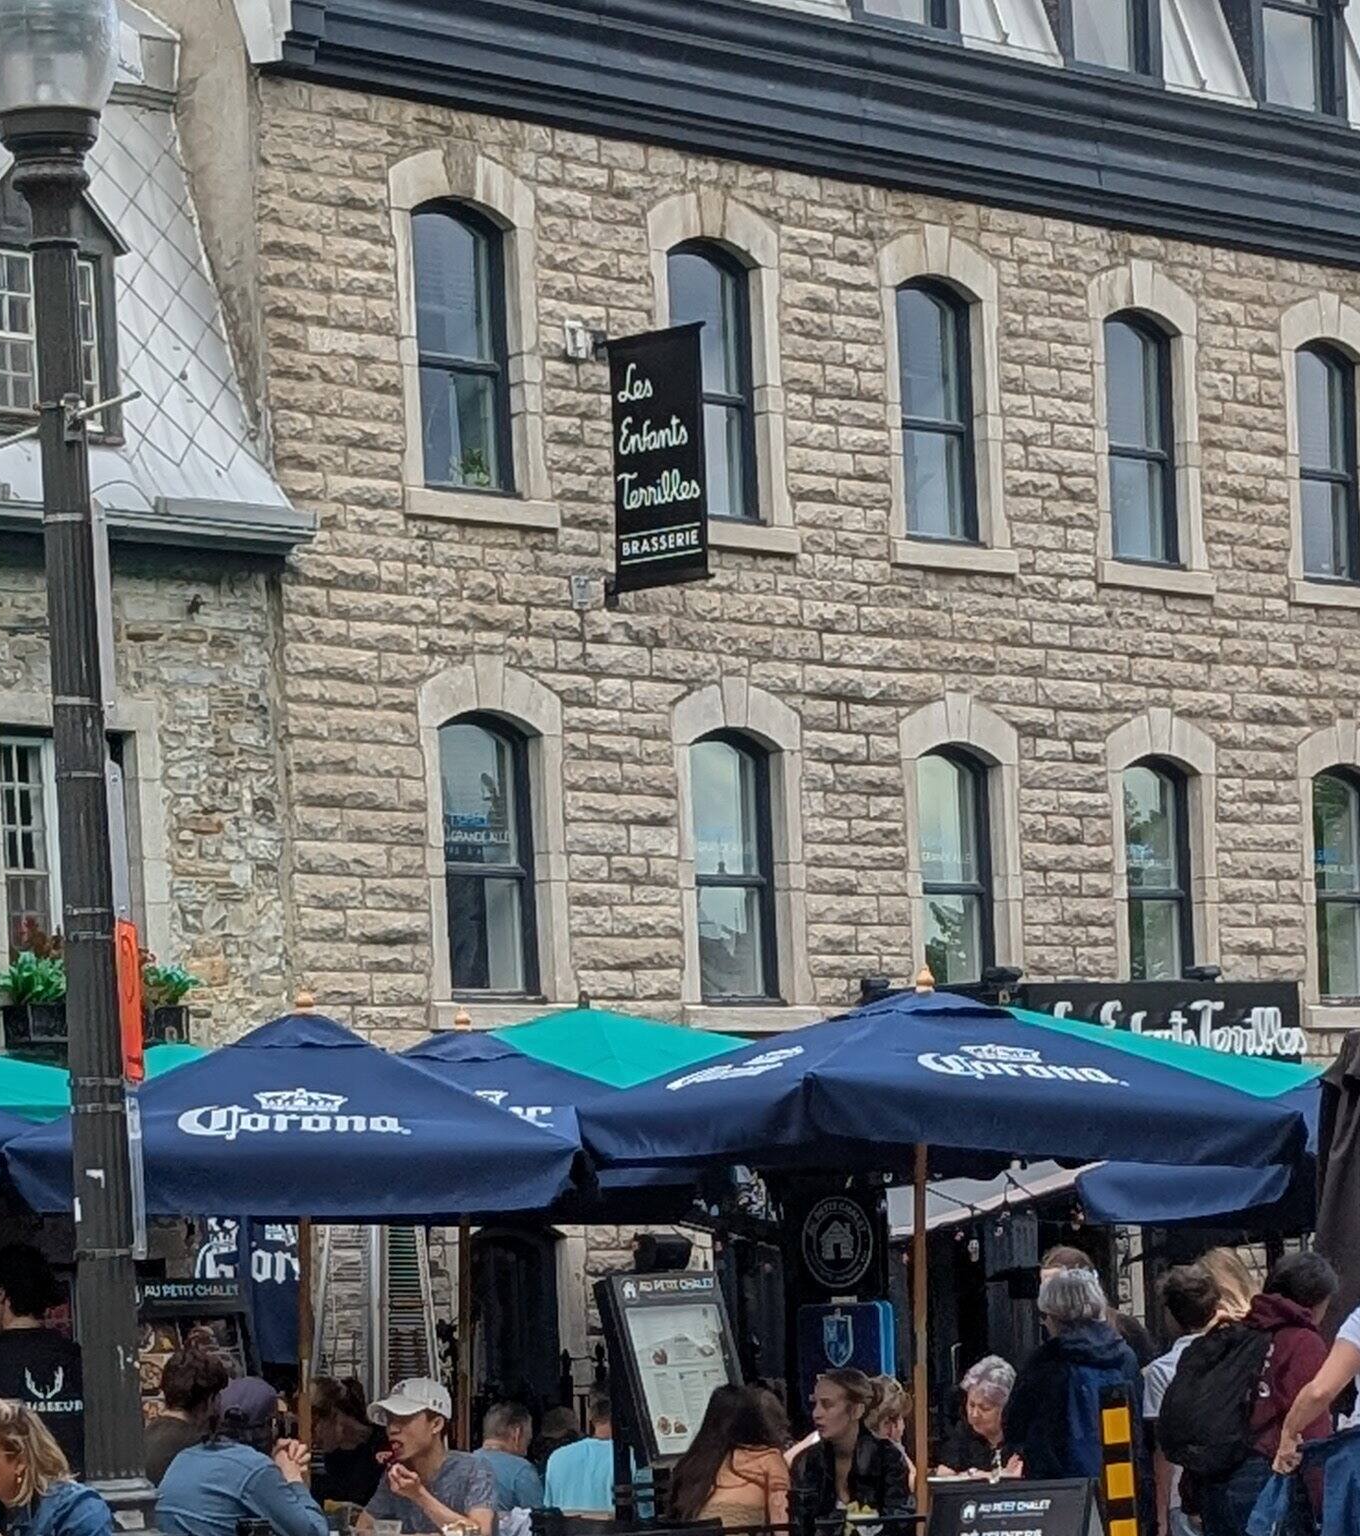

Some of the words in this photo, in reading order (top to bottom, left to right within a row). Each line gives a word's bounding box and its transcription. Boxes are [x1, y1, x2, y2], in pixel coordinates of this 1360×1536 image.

[618, 363, 653, 402] Les
[619, 414, 689, 455] Enfants
[622, 529, 700, 556] BRASSERIE
[917, 1052, 1119, 1081] Corona
[177, 1104, 403, 1140] Corona
